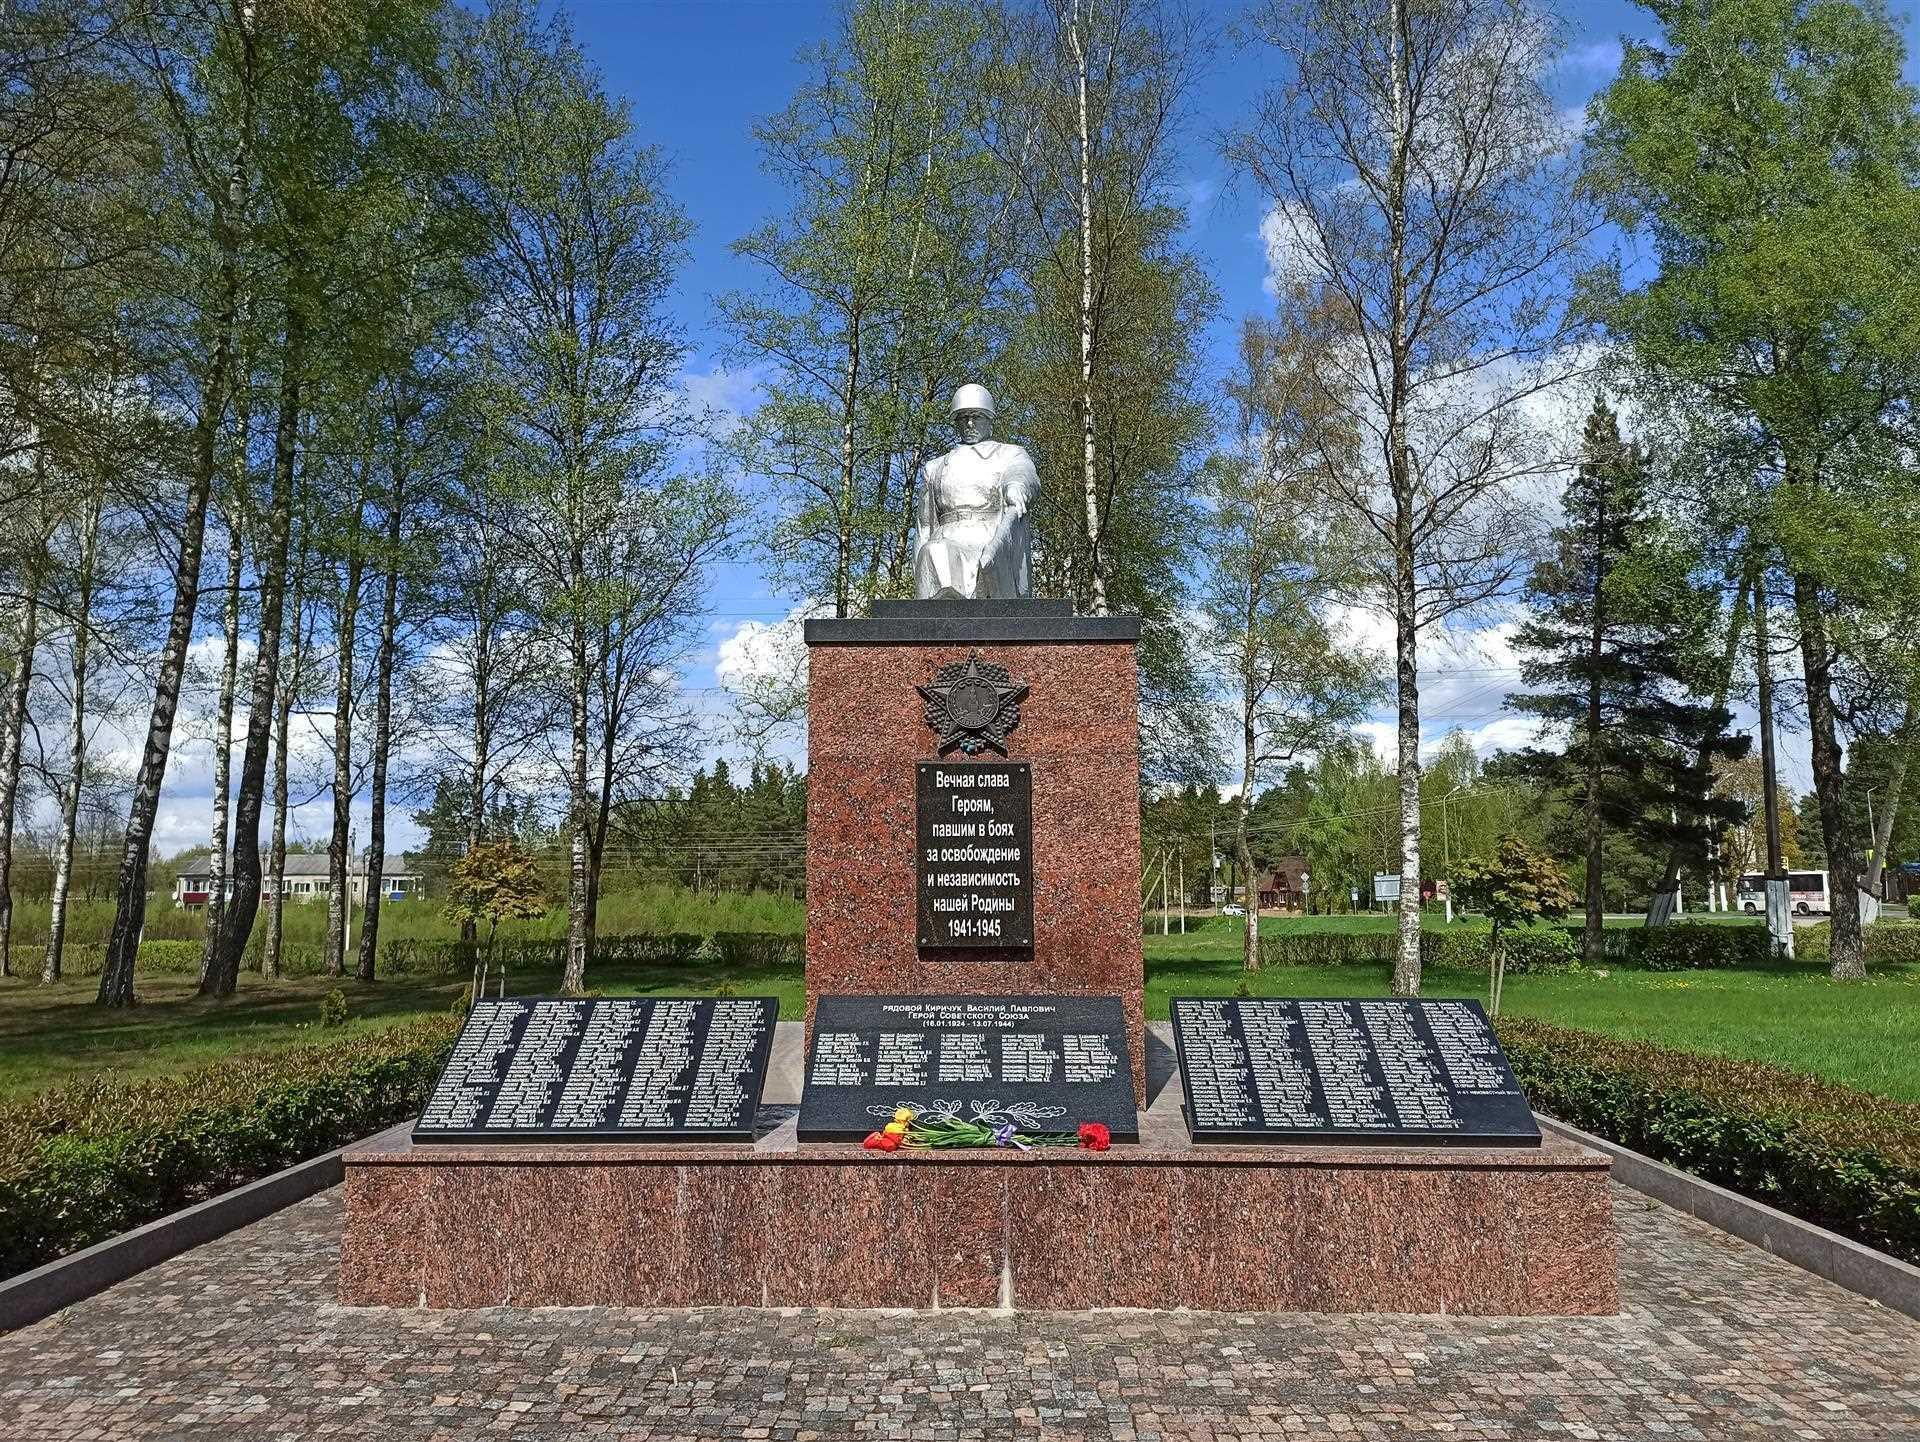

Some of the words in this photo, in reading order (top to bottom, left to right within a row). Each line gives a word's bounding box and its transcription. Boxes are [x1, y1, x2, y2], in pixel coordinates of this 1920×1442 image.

[936, 771, 975, 788] Вечная
[978, 774, 1010, 788] слава
[952, 795, 994, 816] Героям,
[932, 823, 976, 837] павшим
[979, 823, 985, 836] в
[988, 819, 1015, 837] боях
[927, 848, 938, 862] за
[941, 844, 1021, 864] освобождение
[927, 874, 934, 887] и
[937, 873, 1021, 887] независимость
[933, 894, 968, 912] нашей
[971, 894, 1015, 914] Родины
[948, 919, 1001, 937] 1941-1945
